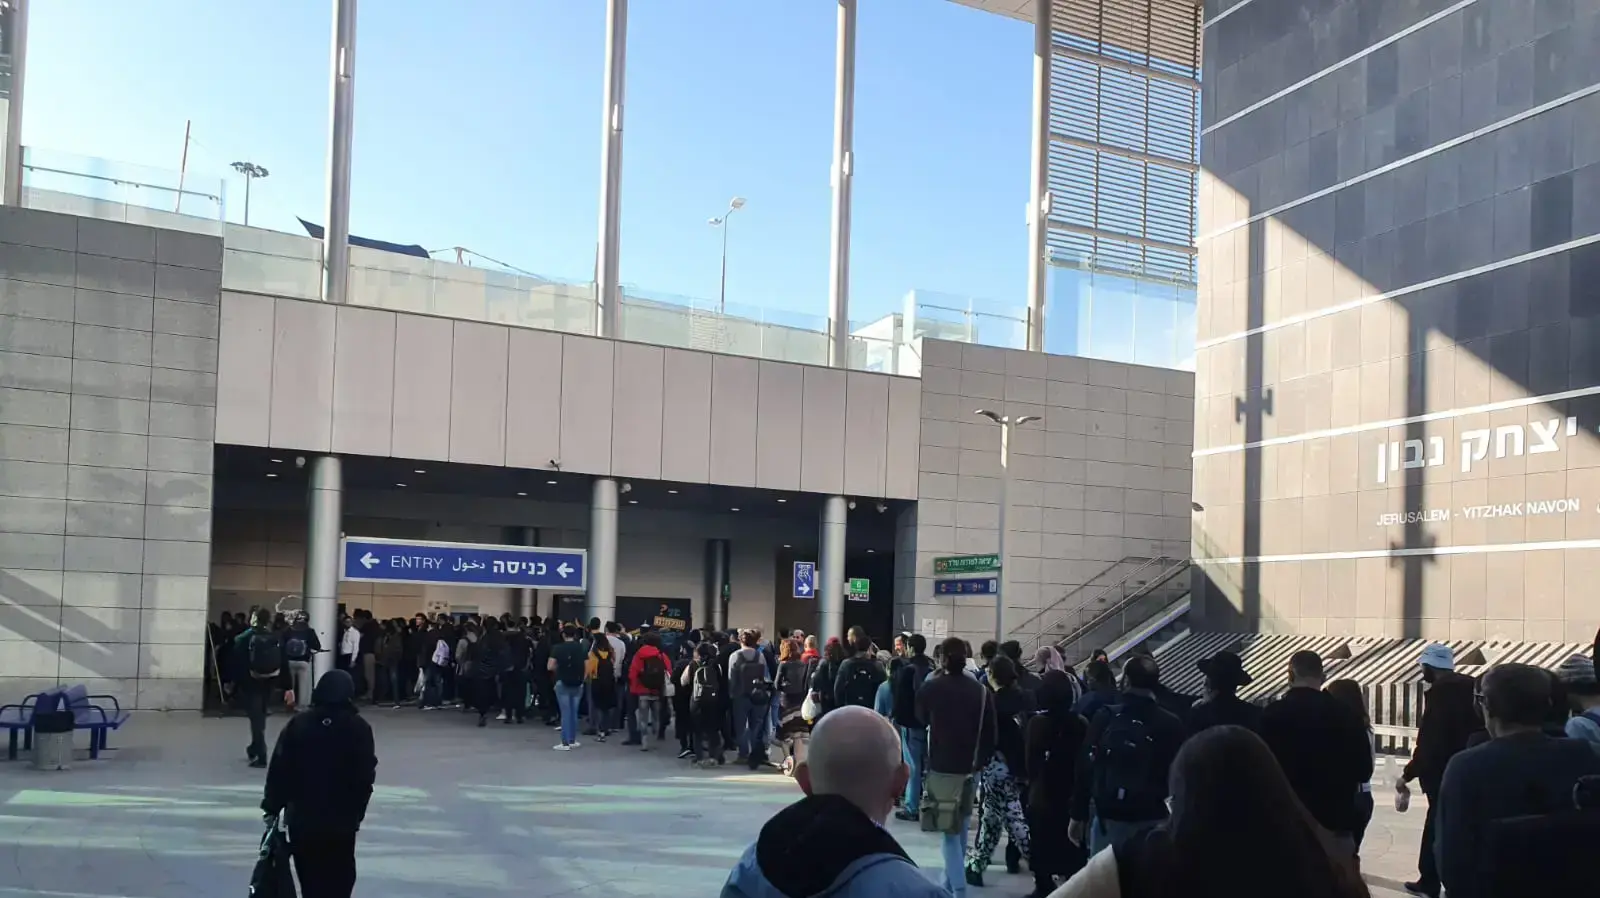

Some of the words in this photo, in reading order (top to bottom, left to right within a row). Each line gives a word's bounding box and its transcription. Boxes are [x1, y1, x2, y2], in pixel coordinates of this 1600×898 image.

[1461, 416, 1577, 473] יצחק
[1377, 436, 1445, 483] נבון
[1376, 508, 1450, 526] JERUSALEM
[1462, 502, 1523, 519] YITZHAK
[1526, 498, 1580, 516] NAVON
[391, 555, 444, 569] ENTRY
[452, 557, 486, 572] دخول
[493, 560, 547, 575] כניסה
